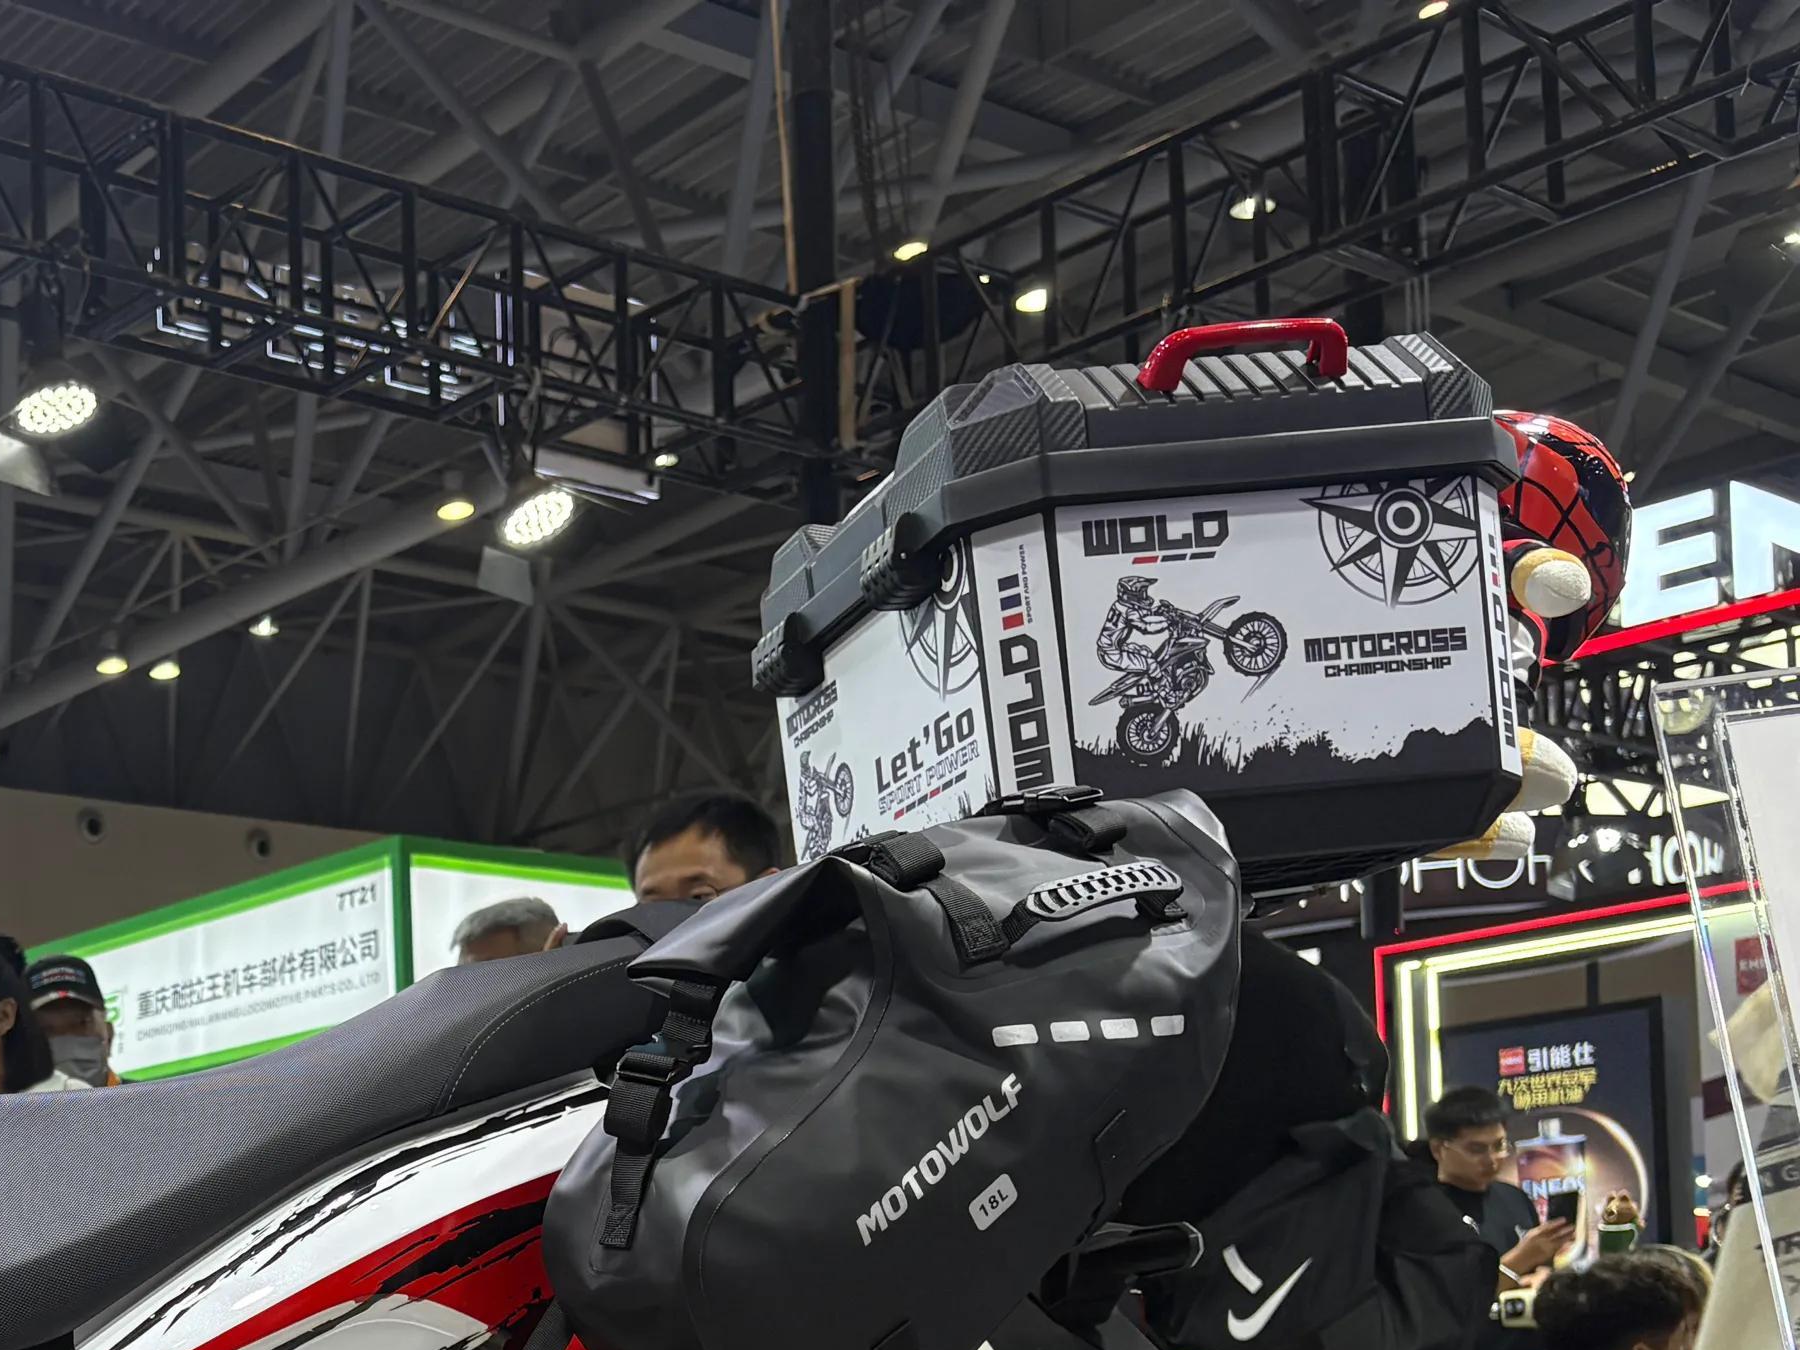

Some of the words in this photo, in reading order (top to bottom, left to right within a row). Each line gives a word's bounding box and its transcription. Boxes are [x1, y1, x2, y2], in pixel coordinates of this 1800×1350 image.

[1082, 510, 1229, 557] WOLD
[1303, 626, 1468, 664] MOTOCROSS
[1324, 655, 1453, 679] CHAMPIONSHIP
[999, 633, 1055, 792] WOLD
[856, 1073, 1022, 1247] MOTOWOLF
[978, 1189, 1009, 1217] 18L
